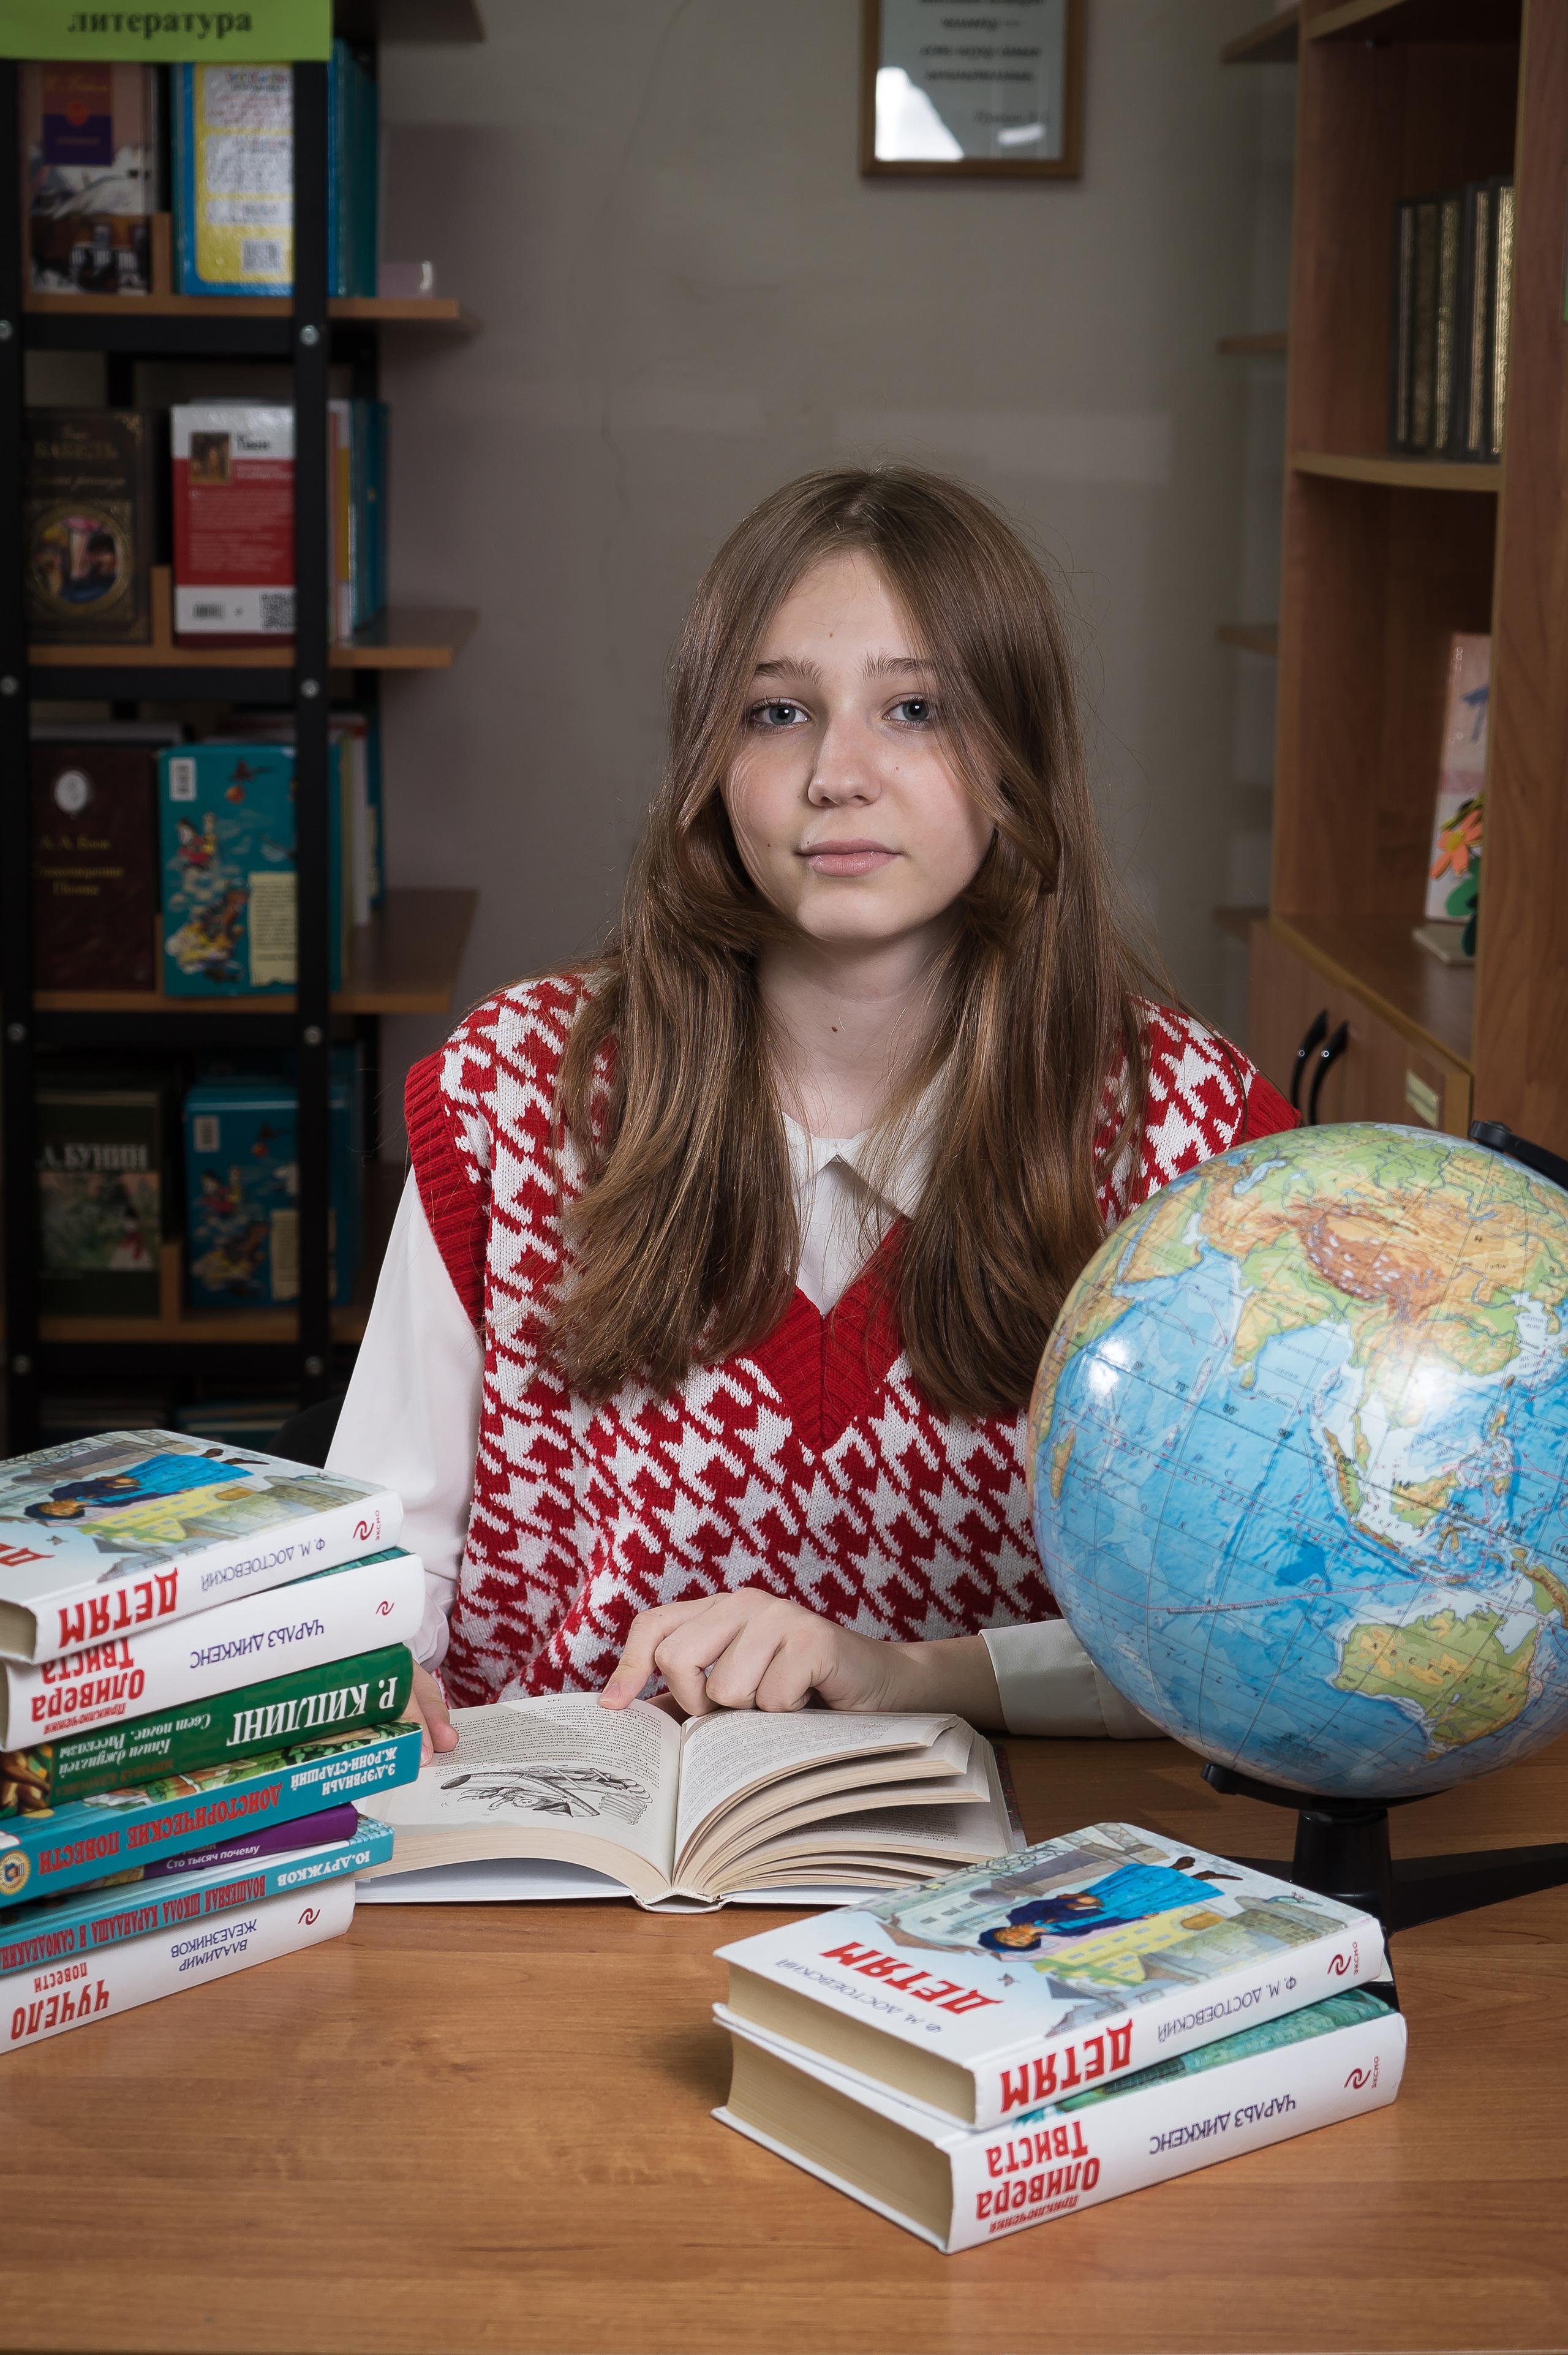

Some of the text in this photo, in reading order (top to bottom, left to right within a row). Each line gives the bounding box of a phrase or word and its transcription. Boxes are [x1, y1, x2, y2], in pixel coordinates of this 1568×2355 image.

[67, 9, 252, 40] литература
[200, 1537, 325, 1592] Ф. М. ДОСТОЕВСКИЙ
[58, 1566, 178, 1649] ДЕТЯМ
[190, 1619, 325, 1669] ЧАРЛЬЗ ДИККЕНС
[225, 1676, 398, 1747] Р. КИПЛИНГ
[126, 1782, 284, 1849] ДОИСТОРИЧЕСКИЕ
[38, 1831, 121, 1875] ПОВЕСТИ
[167, 1859, 185, 1870] Сто
[187, 1853, 218, 1866] тысяч
[220, 1844, 260, 1861] почему
[0, 1874, 266, 1970] ВОЛШЕБНАЯ ШКОЛА КАРАНДАША И САМОДЕЛКИН
[171, 1918, 258, 1958] ЖЕЛЕЗНИКОВ
[34, 1961, 88, 1993] ПОВЕСТИ
[178, 1938, 248, 1972] ВЛАДИМИР
[818, 1941, 1005, 2014] ДЕТЯМ
[10, 1978, 110, 2041] ЧУЧЕЛО
[774, 1957, 905, 2014] ДОСТОЕВСКИЙ
[1158, 1976, 1298, 2043] Ф. М. ДОСТОЕВСКИЙ
[1000, 2017, 1134, 2114] ДЕТЯМ
[1371, 2055, 1381, 2089] ЭКСМО
[1149, 2093, 1296, 2155] ЧАРЛЬЗ ДИККЕНС
